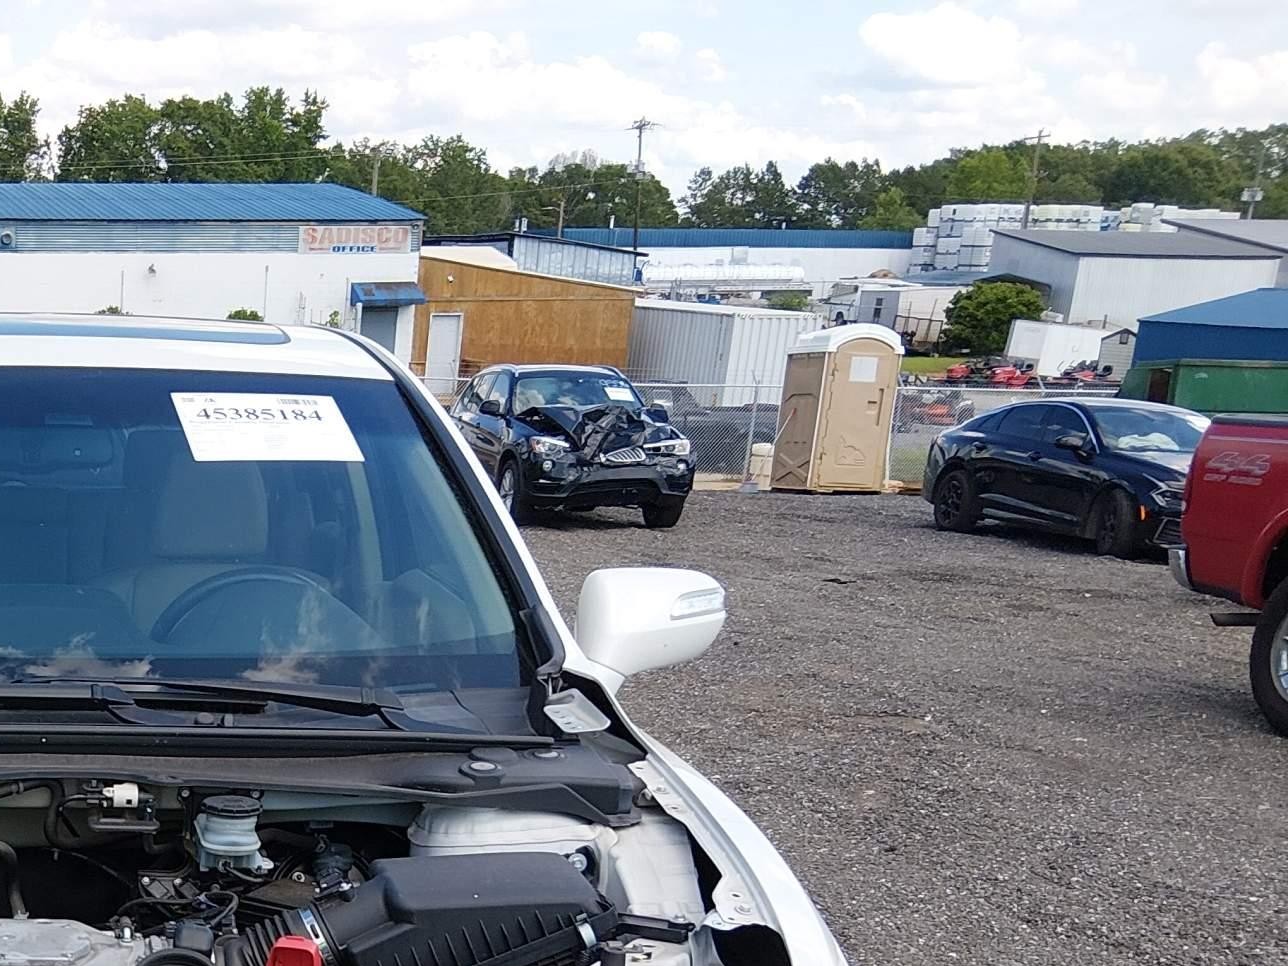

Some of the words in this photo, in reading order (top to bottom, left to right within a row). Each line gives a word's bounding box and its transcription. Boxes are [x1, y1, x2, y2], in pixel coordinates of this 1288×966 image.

[304, 227, 409, 245] SADISCO
[331, 245, 377, 253] OFFICE
[196, 407, 323, 422] 45385184
